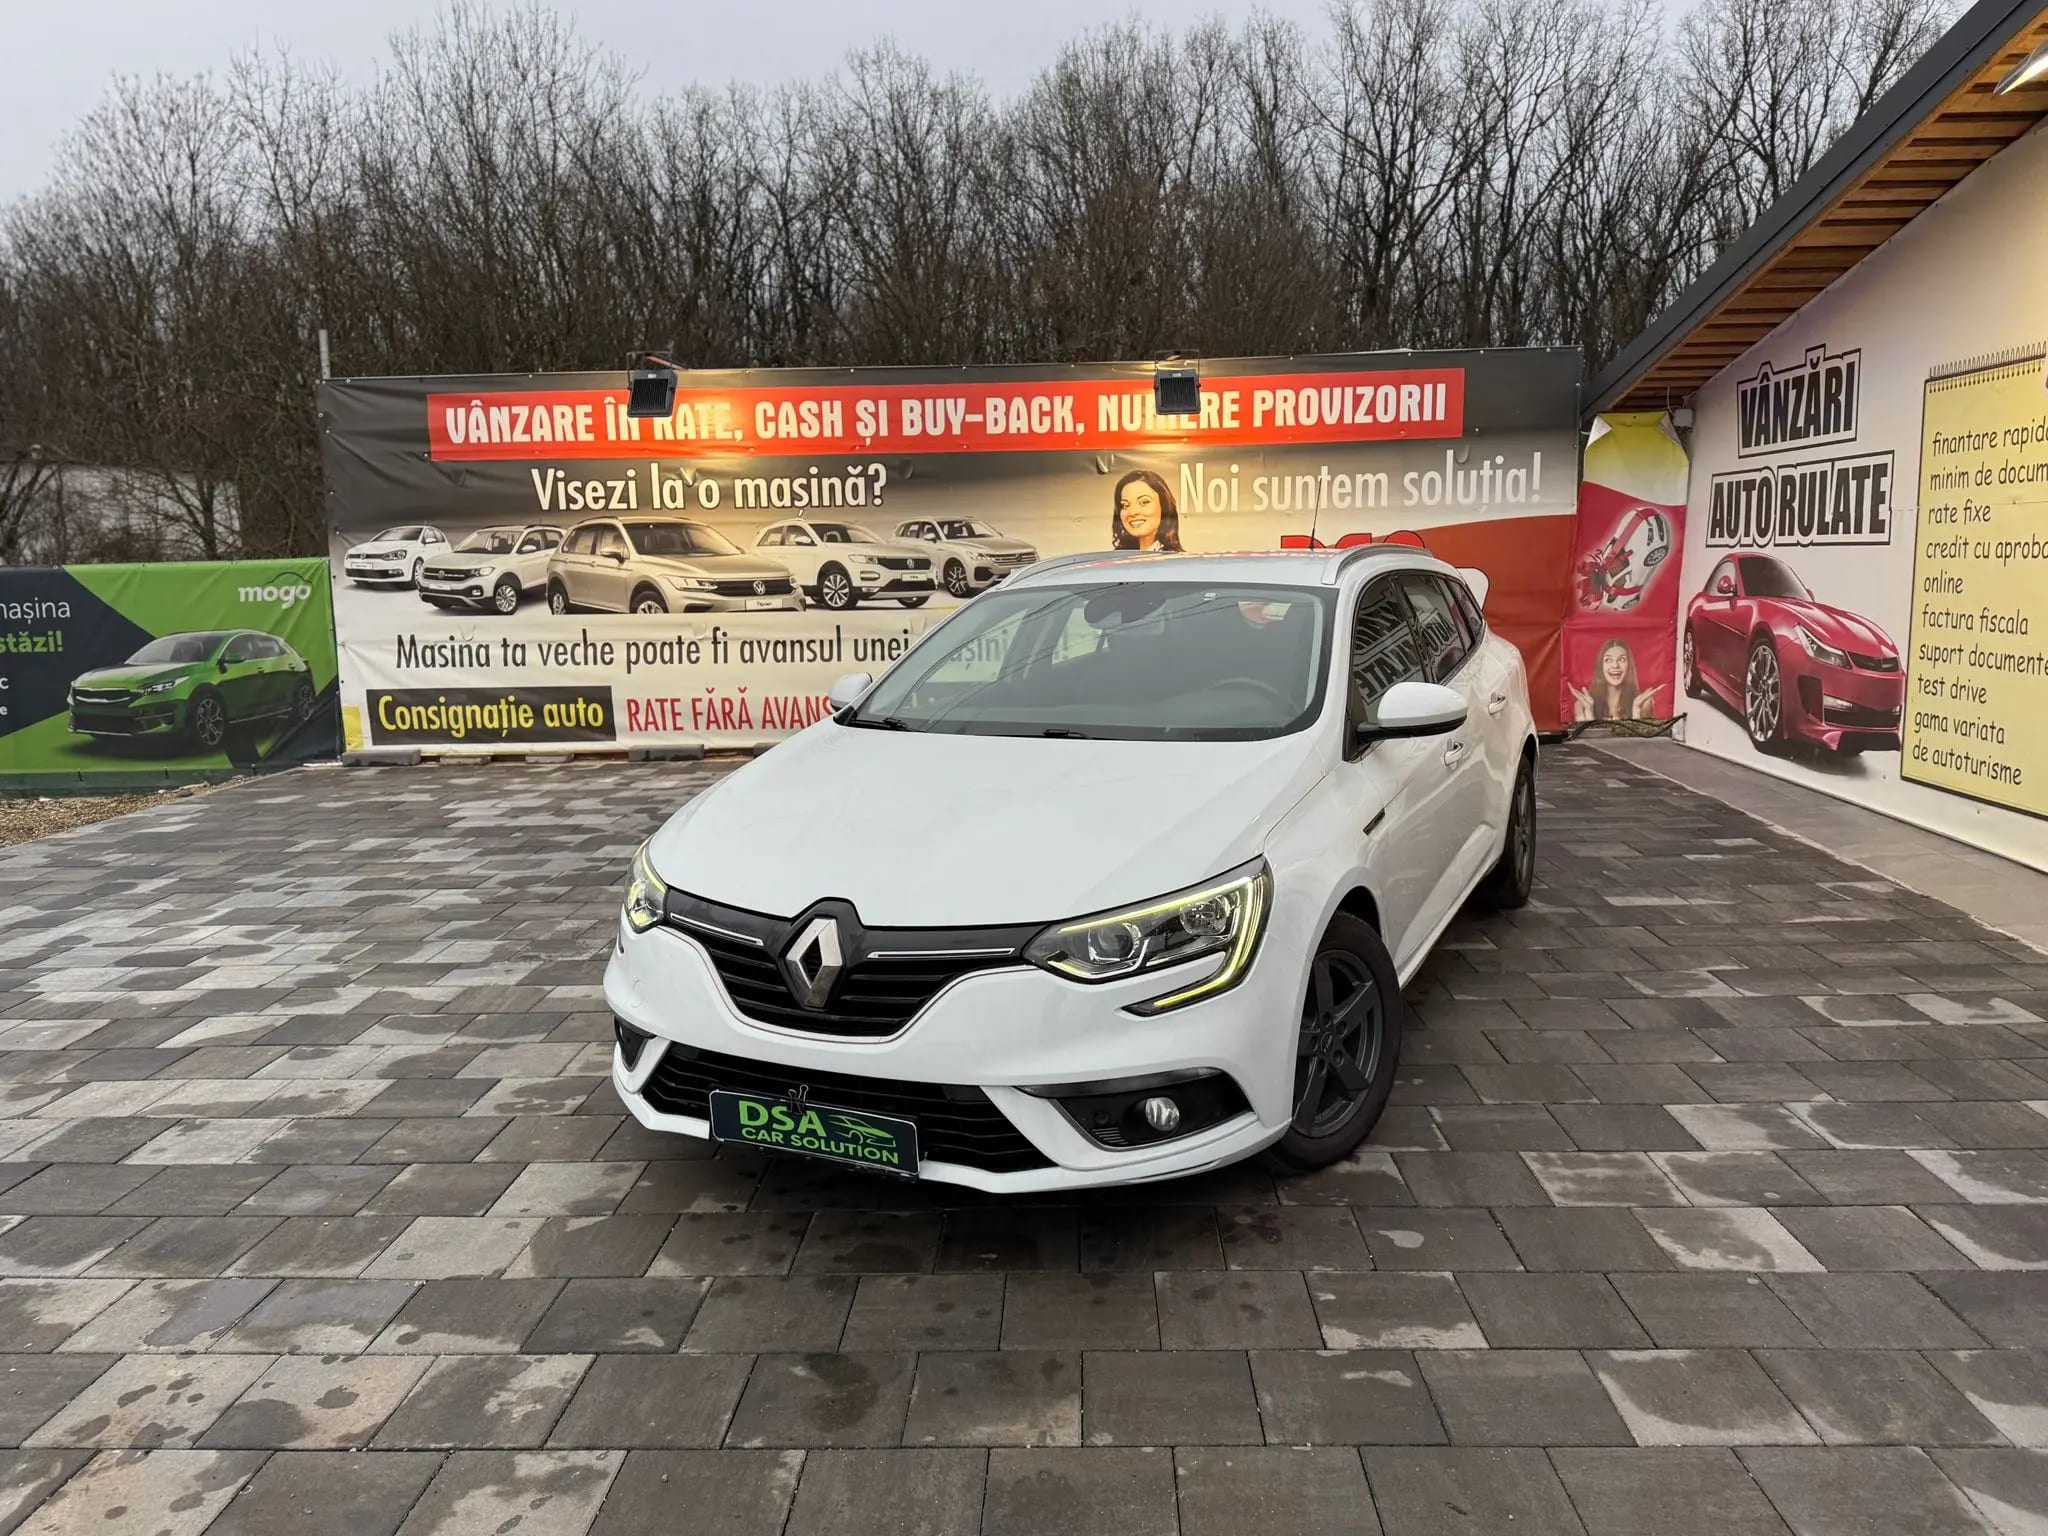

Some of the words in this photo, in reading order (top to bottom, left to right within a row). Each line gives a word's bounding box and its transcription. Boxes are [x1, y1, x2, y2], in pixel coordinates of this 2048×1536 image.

[446, 400, 595, 443] VÂNZARE
[604, 396, 640, 441] ÎN
[755, 400, 843, 439] CASH
[855, 399, 888, 446] ȘI
[902, 395, 1085, 436] BUY-BACK,
[1253, 383, 1446, 428] PROVIZORII
[1741, 356, 1855, 448] VÂNZĂRI
[1932, 430, 1998, 457] finantare
[2003, 416, 2048, 453] rapid
[531, 468, 638, 511] Visezi
[650, 462, 685, 509] la
[699, 478, 720, 509] o
[734, 463, 887, 517] mașină?
[1180, 463, 1239, 513] Noi
[1253, 465, 1389, 511] suntem
[1403, 449, 1541, 513] soluția!
[1930, 466, 1969, 491] minim
[1975, 462, 1993, 487] de
[1710, 476, 1772, 539] AUTO
[1778, 463, 1888, 537] RULATE
[1928, 503, 1958, 525] rate
[1964, 499, 1991, 525] fixe
[1926, 534, 1969, 559] credit
[1973, 542, 1990, 559] cu
[238, 581, 312, 609] mogo
[1923, 570, 1964, 594] online
[1922, 604, 1974, 630] factura
[1980, 607, 2029, 635] fiscala
[501, 637, 526, 667] ta
[538, 628, 614, 666] veche
[626, 635, 701, 674] poate
[711, 626, 728, 664] fi
[739, 625, 842, 663] avansul
[854, 628, 909, 662] unei
[1919, 643, 1964, 669] suport
[1917, 673, 1946, 697] test
[1950, 676, 1988, 705] drive
[378, 695, 534, 738] Consignație
[543, 697, 604, 727] auto
[626, 698, 684, 732] RATE
[691, 686, 754, 730] FĂRĂ
[1914, 711, 1948, 734] gama
[1953, 717, 2005, 745] variata
[1912, 738, 1928, 762] de
[1932, 749, 2023, 785] autoturisme
[738, 1100, 827, 1137] DSA
[741, 1126, 785, 1144] CAR
[790, 1135, 899, 1165] SOLUTION
